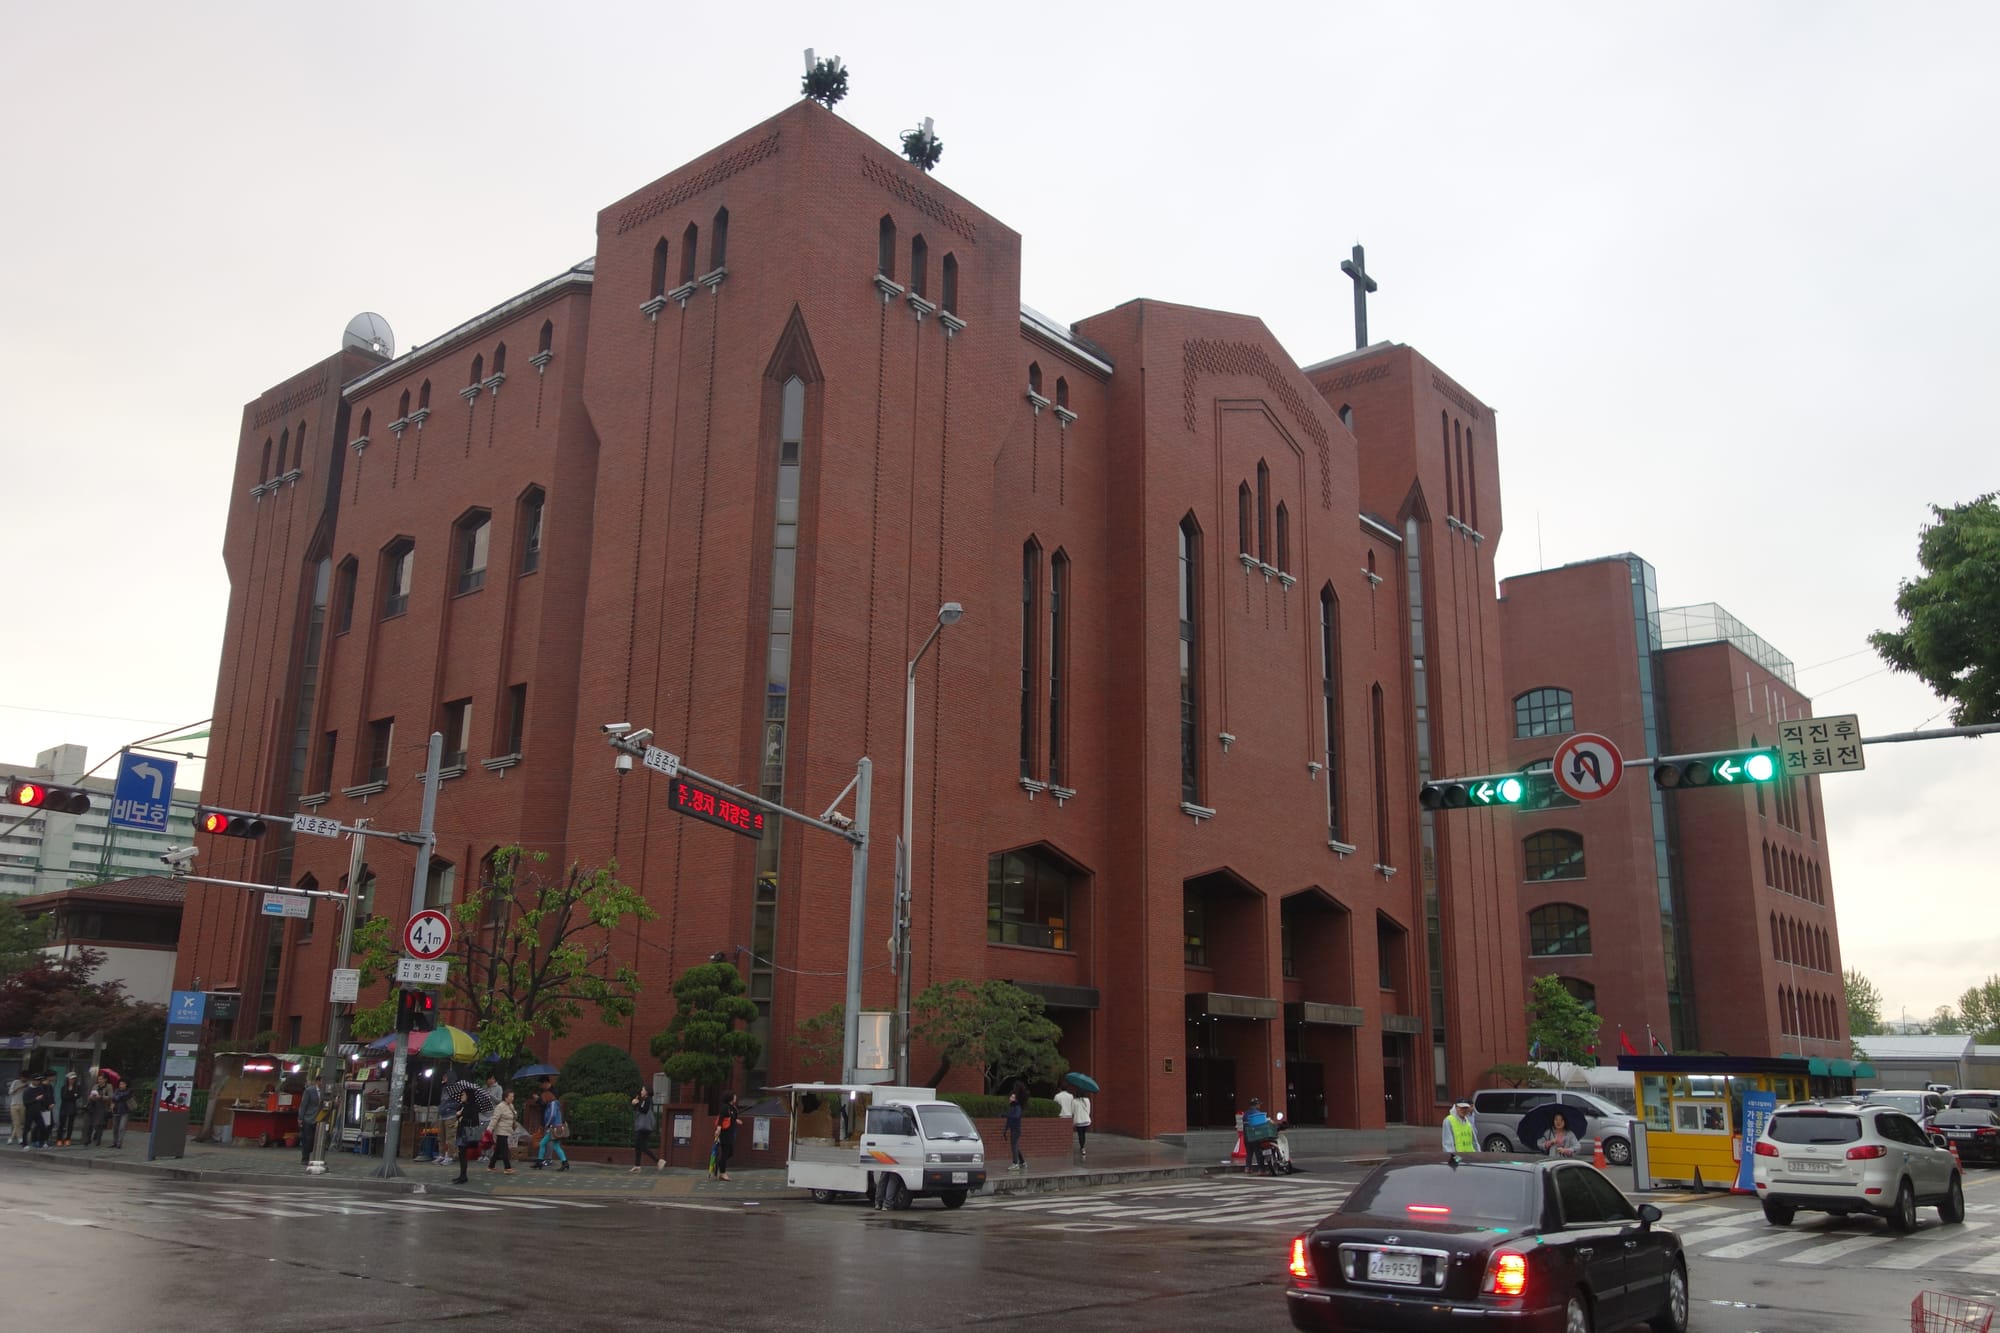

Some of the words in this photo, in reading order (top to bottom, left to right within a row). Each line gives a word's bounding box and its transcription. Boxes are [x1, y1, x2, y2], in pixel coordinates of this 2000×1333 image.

[1784, 721, 1856, 745] 직진후
[646, 750, 676, 773] 신호준수
[1787, 745, 1859, 769] 좌회전
[113, 799, 166, 826] 비보호
[718, 799, 751, 830] 차량은
[296, 816, 337, 835] 신호준수
[413, 925, 441, 945] 4.1m
[403, 971, 441, 981] 지하차도
[425, 963, 443, 972] 50m
